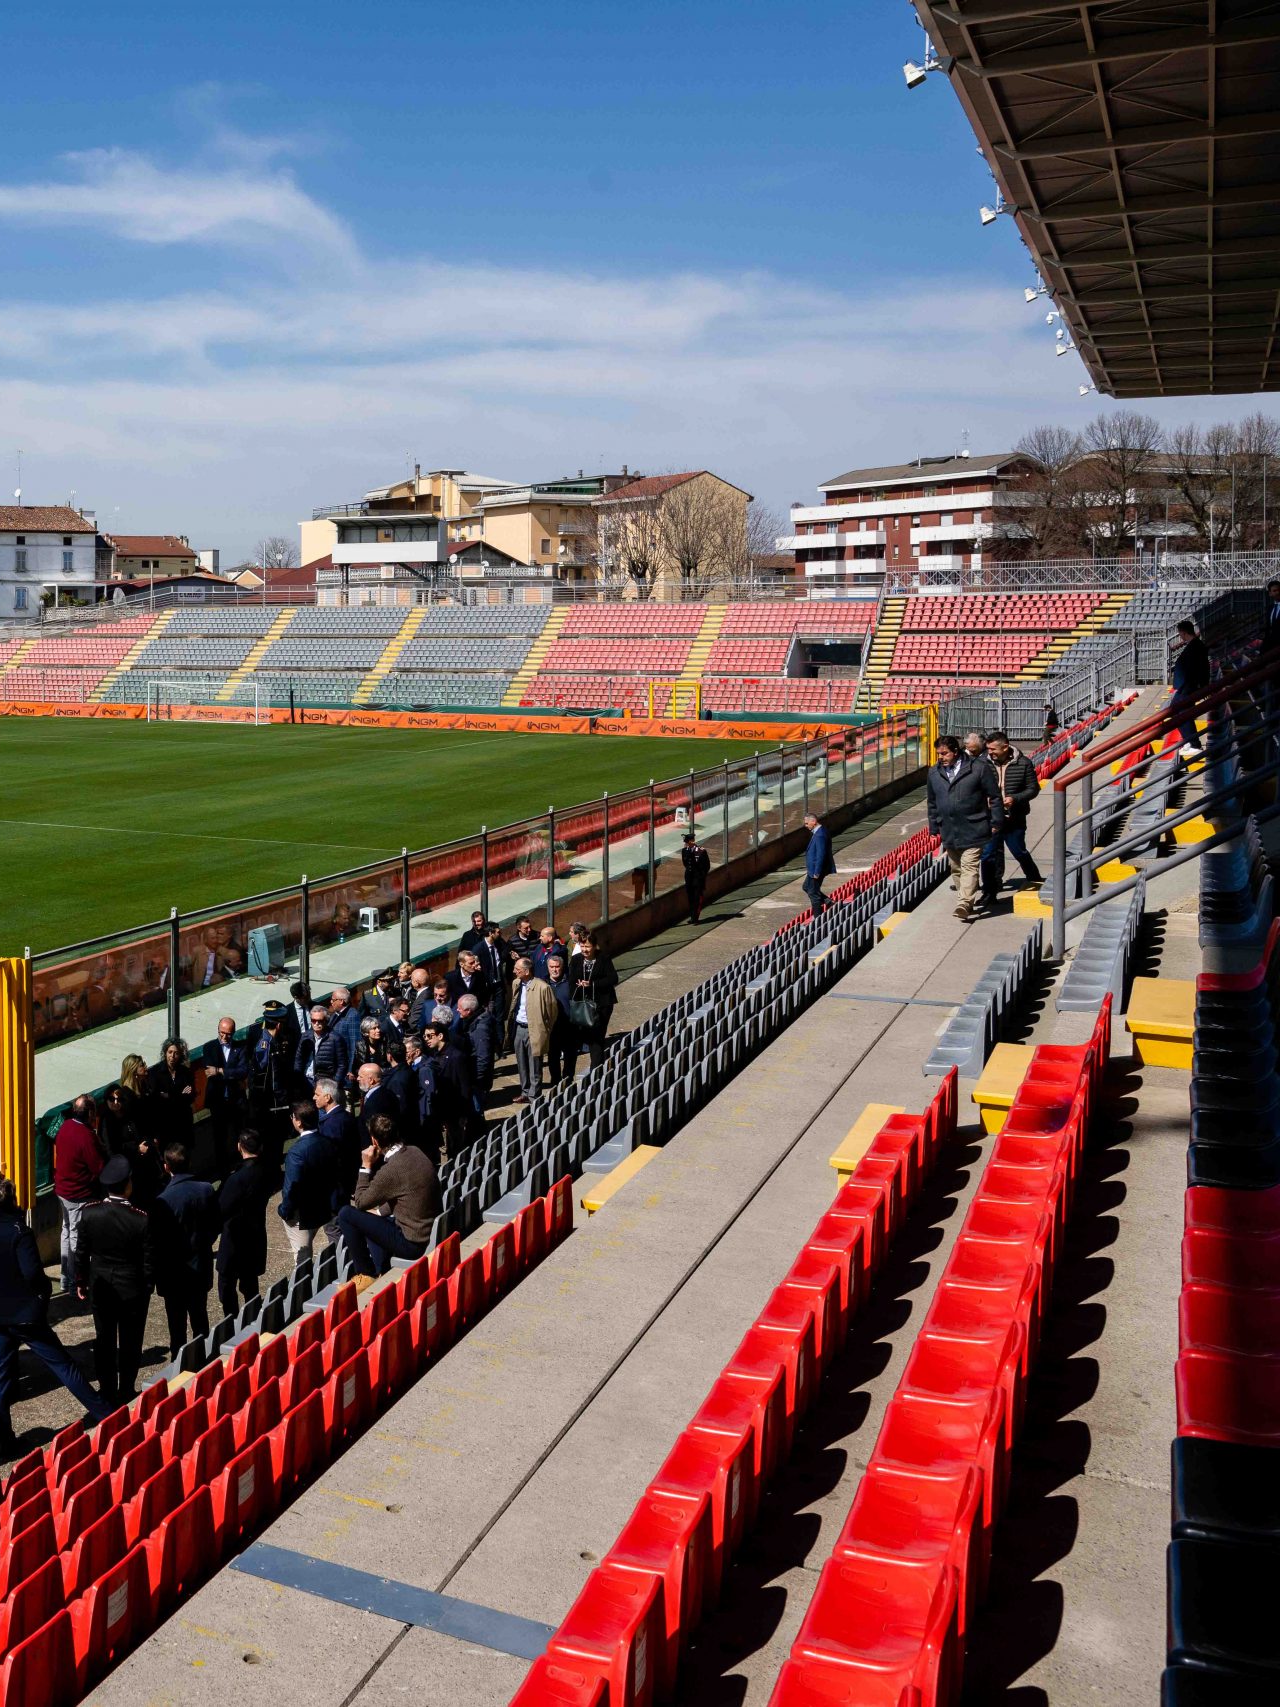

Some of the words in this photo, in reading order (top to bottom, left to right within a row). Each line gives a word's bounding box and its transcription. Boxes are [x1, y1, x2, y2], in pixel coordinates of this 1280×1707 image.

[11, 704, 34, 715] NGM
[56, 708, 80, 717] NGM
[101, 708, 126, 717] NGM
[196, 709, 222, 719] NGM
[299, 712, 327, 721] NGM
[351, 714, 380, 724] NGM
[408, 716, 438, 726] NGM
[466, 719, 496, 729] NGM
[527, 721, 559, 731] NGM
[596, 722, 628, 732] NGM
[660, 724, 695, 735] NGM
[729, 727, 765, 738] NGM
